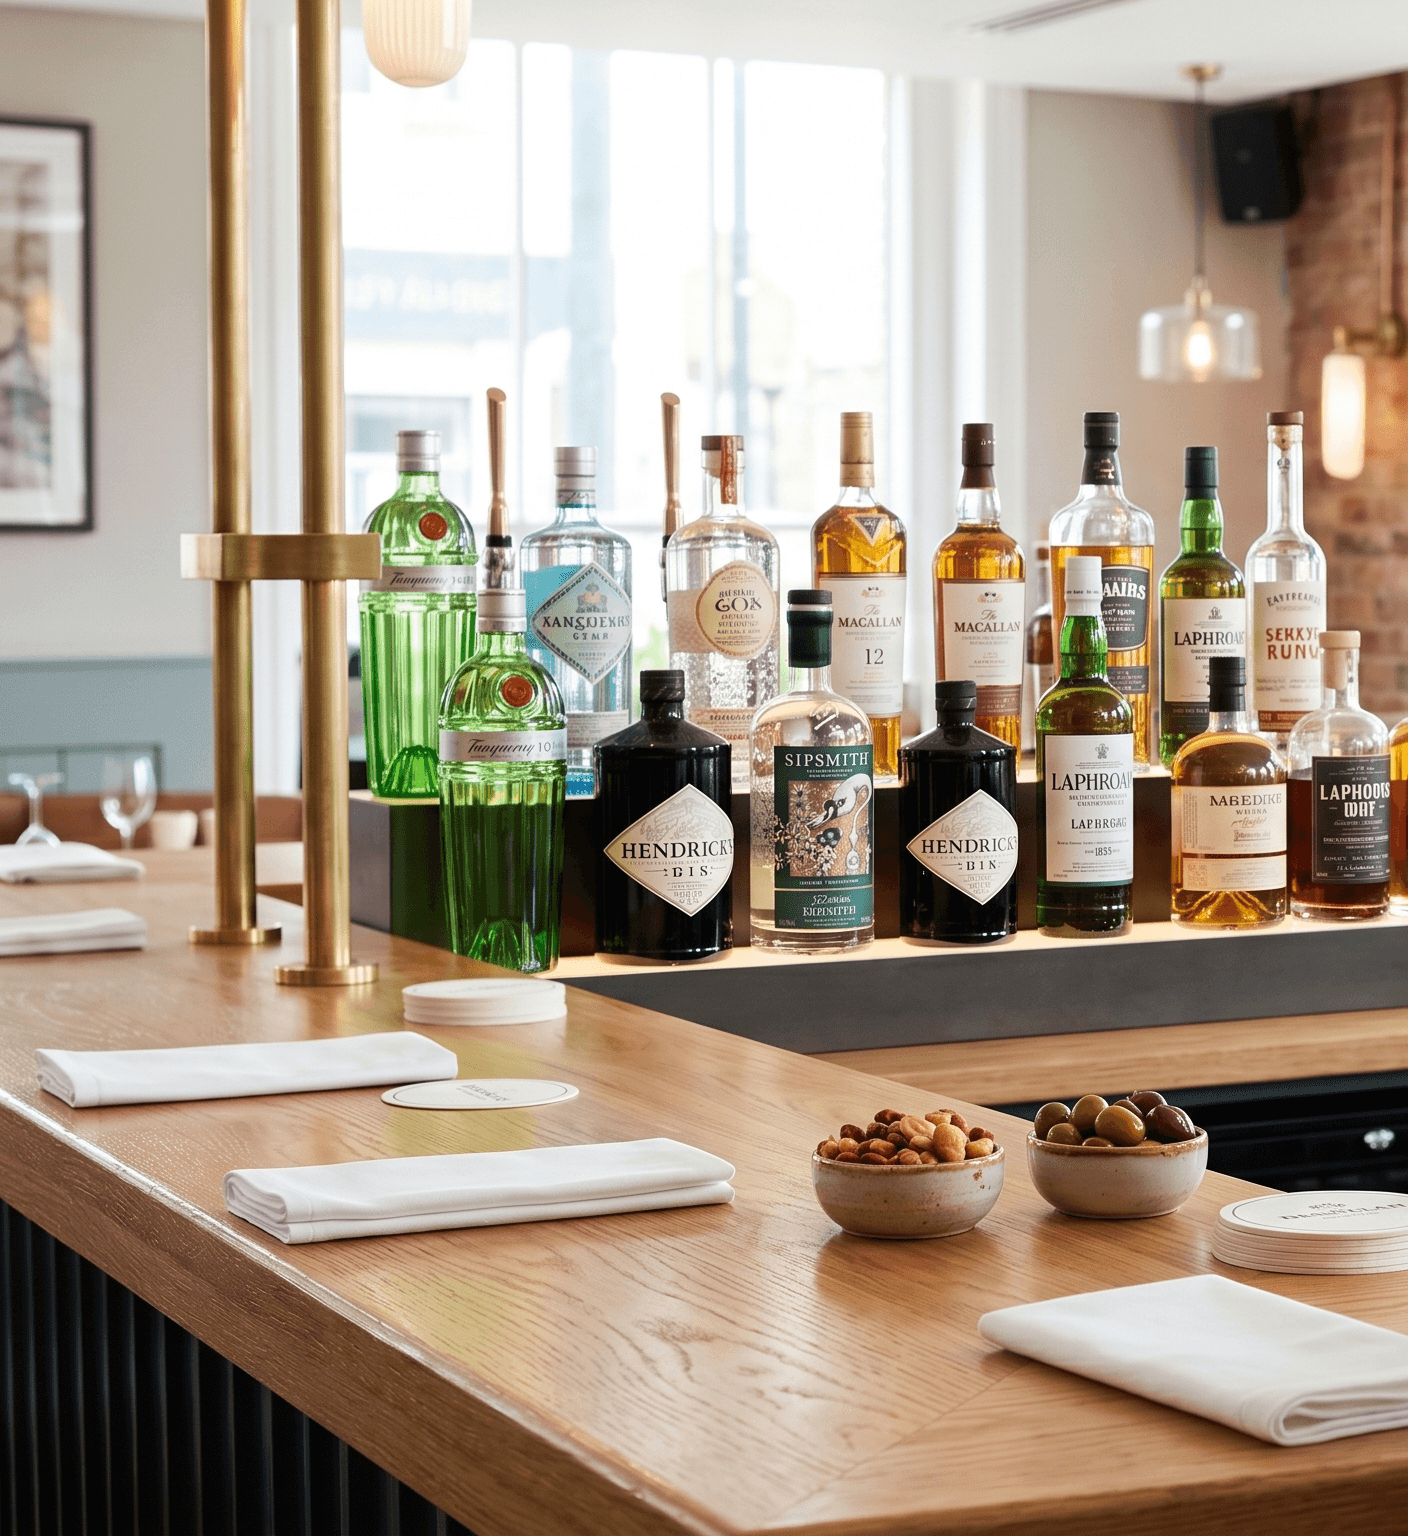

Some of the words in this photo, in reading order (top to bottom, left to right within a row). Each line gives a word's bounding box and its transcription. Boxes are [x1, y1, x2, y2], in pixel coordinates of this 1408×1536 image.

[838, 617, 902, 628] MACALLAN
[954, 621, 1021, 632] MACALLAN
[865, 648, 884, 665] 12
[785, 752, 869, 767] SIPSMITH
